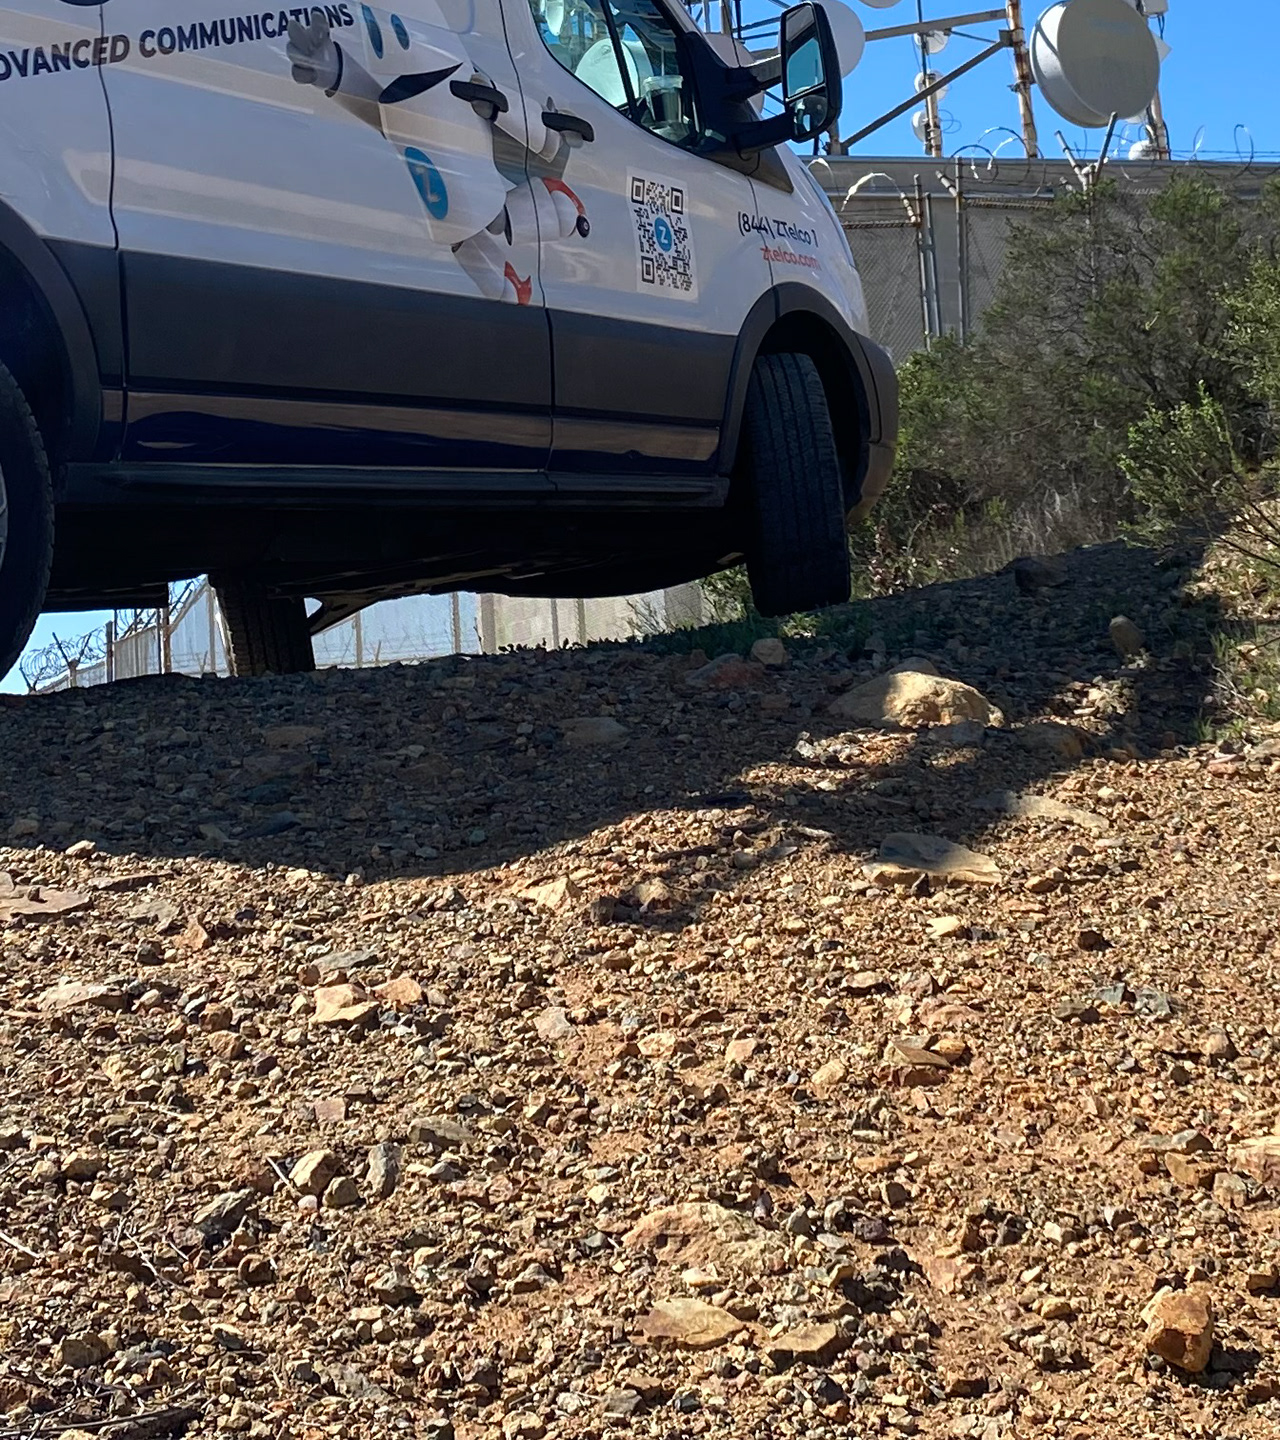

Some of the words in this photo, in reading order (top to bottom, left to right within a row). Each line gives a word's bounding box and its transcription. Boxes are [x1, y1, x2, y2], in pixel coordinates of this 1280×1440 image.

[738, 211, 776, 240] (844)
[772, 218, 812, 245] ZTelco
[810, 229, 819, 248] 1
[760, 246, 822, 271] ztelco.com
